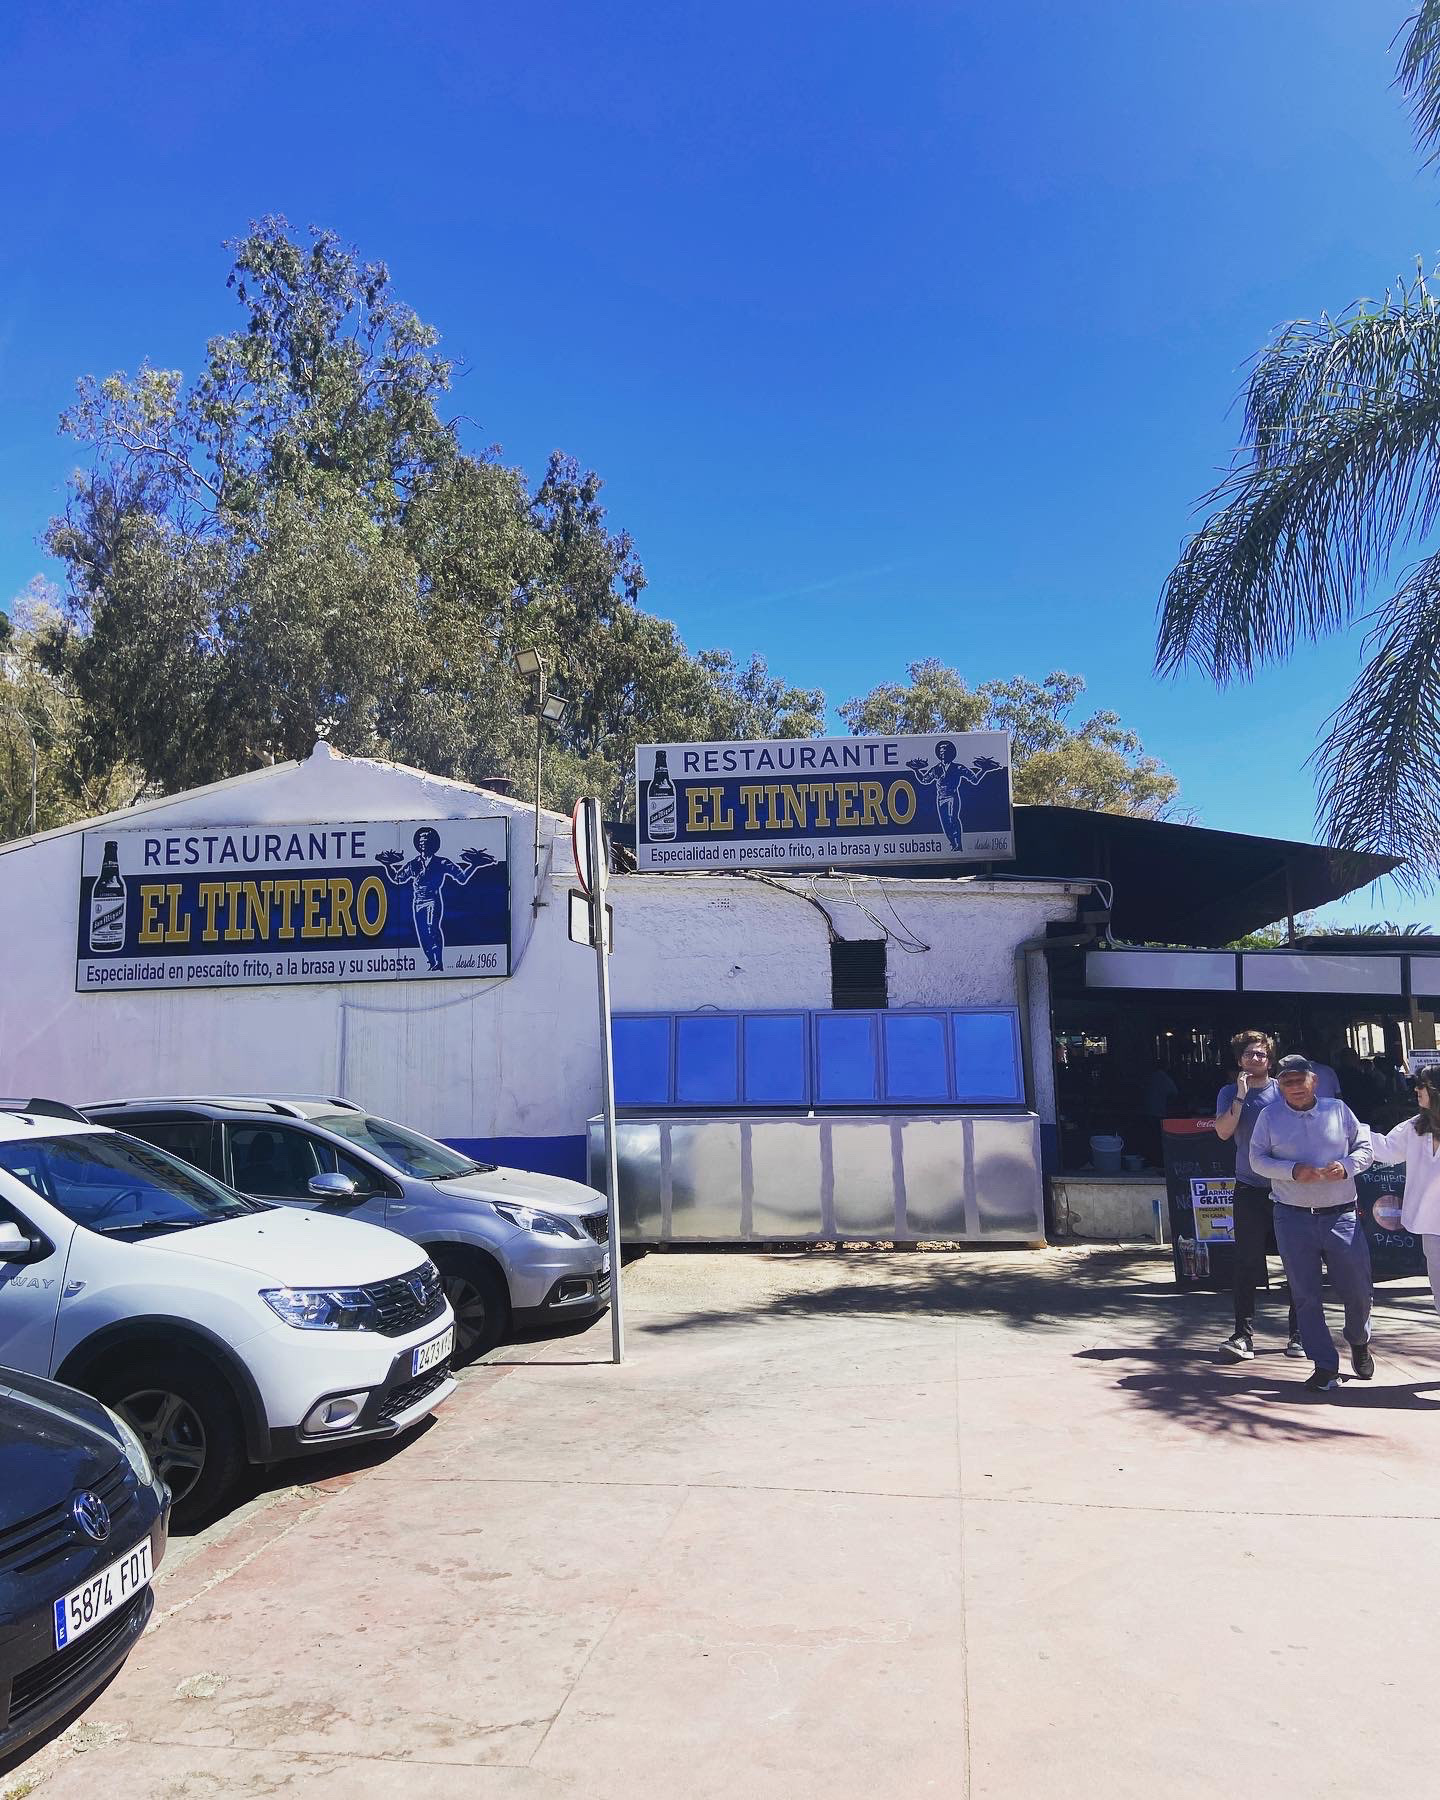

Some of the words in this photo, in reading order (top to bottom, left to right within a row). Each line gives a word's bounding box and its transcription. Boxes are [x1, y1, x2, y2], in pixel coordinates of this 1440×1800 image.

[683, 743, 899, 773] RESTAURANTE
[685, 786, 734, 832] EL
[740, 779, 917, 830] TINTERO
[144, 831, 367, 867] RESTAURANTE
[651, 845, 709, 864] Especialidad
[713, 848, 726, 860] en
[740, 844, 786, 862] pescaíto
[789, 842, 815, 859] frito,
[818, 846, 825, 857] a
[828, 842, 837, 856] la
[841, 841, 870, 856] brasa
[873, 845, 881, 857] y
[884, 844, 896, 855] su
[900, 838, 942, 854] subasta
[991, 838, 1008, 850] 1966
[139, 883, 191, 944] EL
[199, 876, 388, 942] TINTERO
[87, 961, 166, 985] Especialidad
[169, 967, 184, 979] en
[187, 958, 240, 982] pescaíto
[243, 956, 273, 979] frito,
[276, 962, 284, 975] a
[287, 957, 298, 974] la
[301, 957, 335, 975] brasa
[338, 960, 346, 977] y
[349, 960, 364, 974] su
[367, 953, 416, 973] subasta
[477, 951, 497, 969] 1966
[1362, 1173, 1406, 1185] PROHIBID
[1373, 1232, 1415, 1248] PASO
[71, 1573, 113, 1630] 5874
[121, 1545, 148, 1595] FDT
